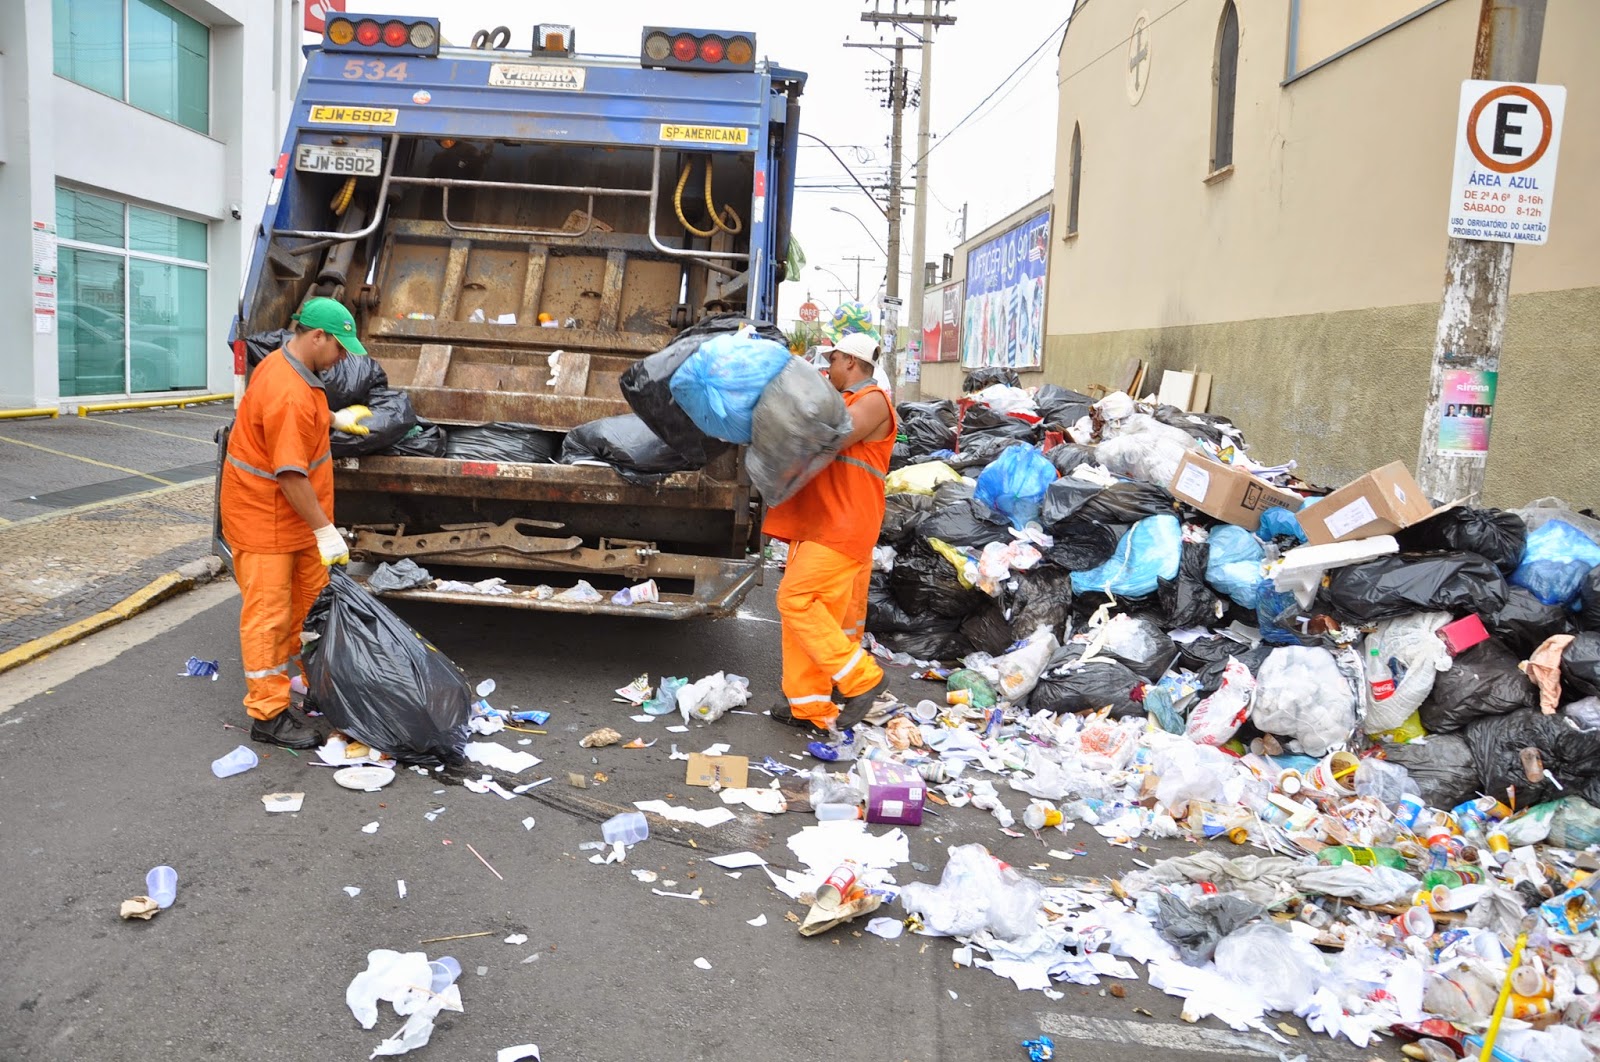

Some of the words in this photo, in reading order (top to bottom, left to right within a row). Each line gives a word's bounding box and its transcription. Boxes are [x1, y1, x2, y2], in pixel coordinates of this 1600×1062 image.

[342, 60, 408, 81] 534
[314, 109, 393, 123] EJW-6902
[666, 127, 742, 141] SP-AMERICANA
[1493, 103, 1528, 157] E
[1468, 171, 1502, 187] ÁREA
[1508, 176, 1539, 190] AZUL
[1464, 190, 1478, 200] DE
[1480, 191, 1490, 200] 2ª
[1491, 193, 1499, 202] A
[1501, 193, 1511, 202] 6ª
[1518, 194, 1544, 205] 8-16h
[1463, 202, 1506, 214] SÁBADO
[1516, 207, 1542, 217] 8-12h
[1451, 217, 1464, 226] USO
[1467, 218, 1508, 229] OBRIGATÓRIO
[1511, 222, 1520, 230] DO
[1522, 222, 1547, 232] CARTÃO
[1453, 227, 1482, 237] PROIBIDO
[1513, 233, 1542, 241] AMARELA
[800, 308, 817, 317] PARE
[1456, 382, 1489, 392] sirena
